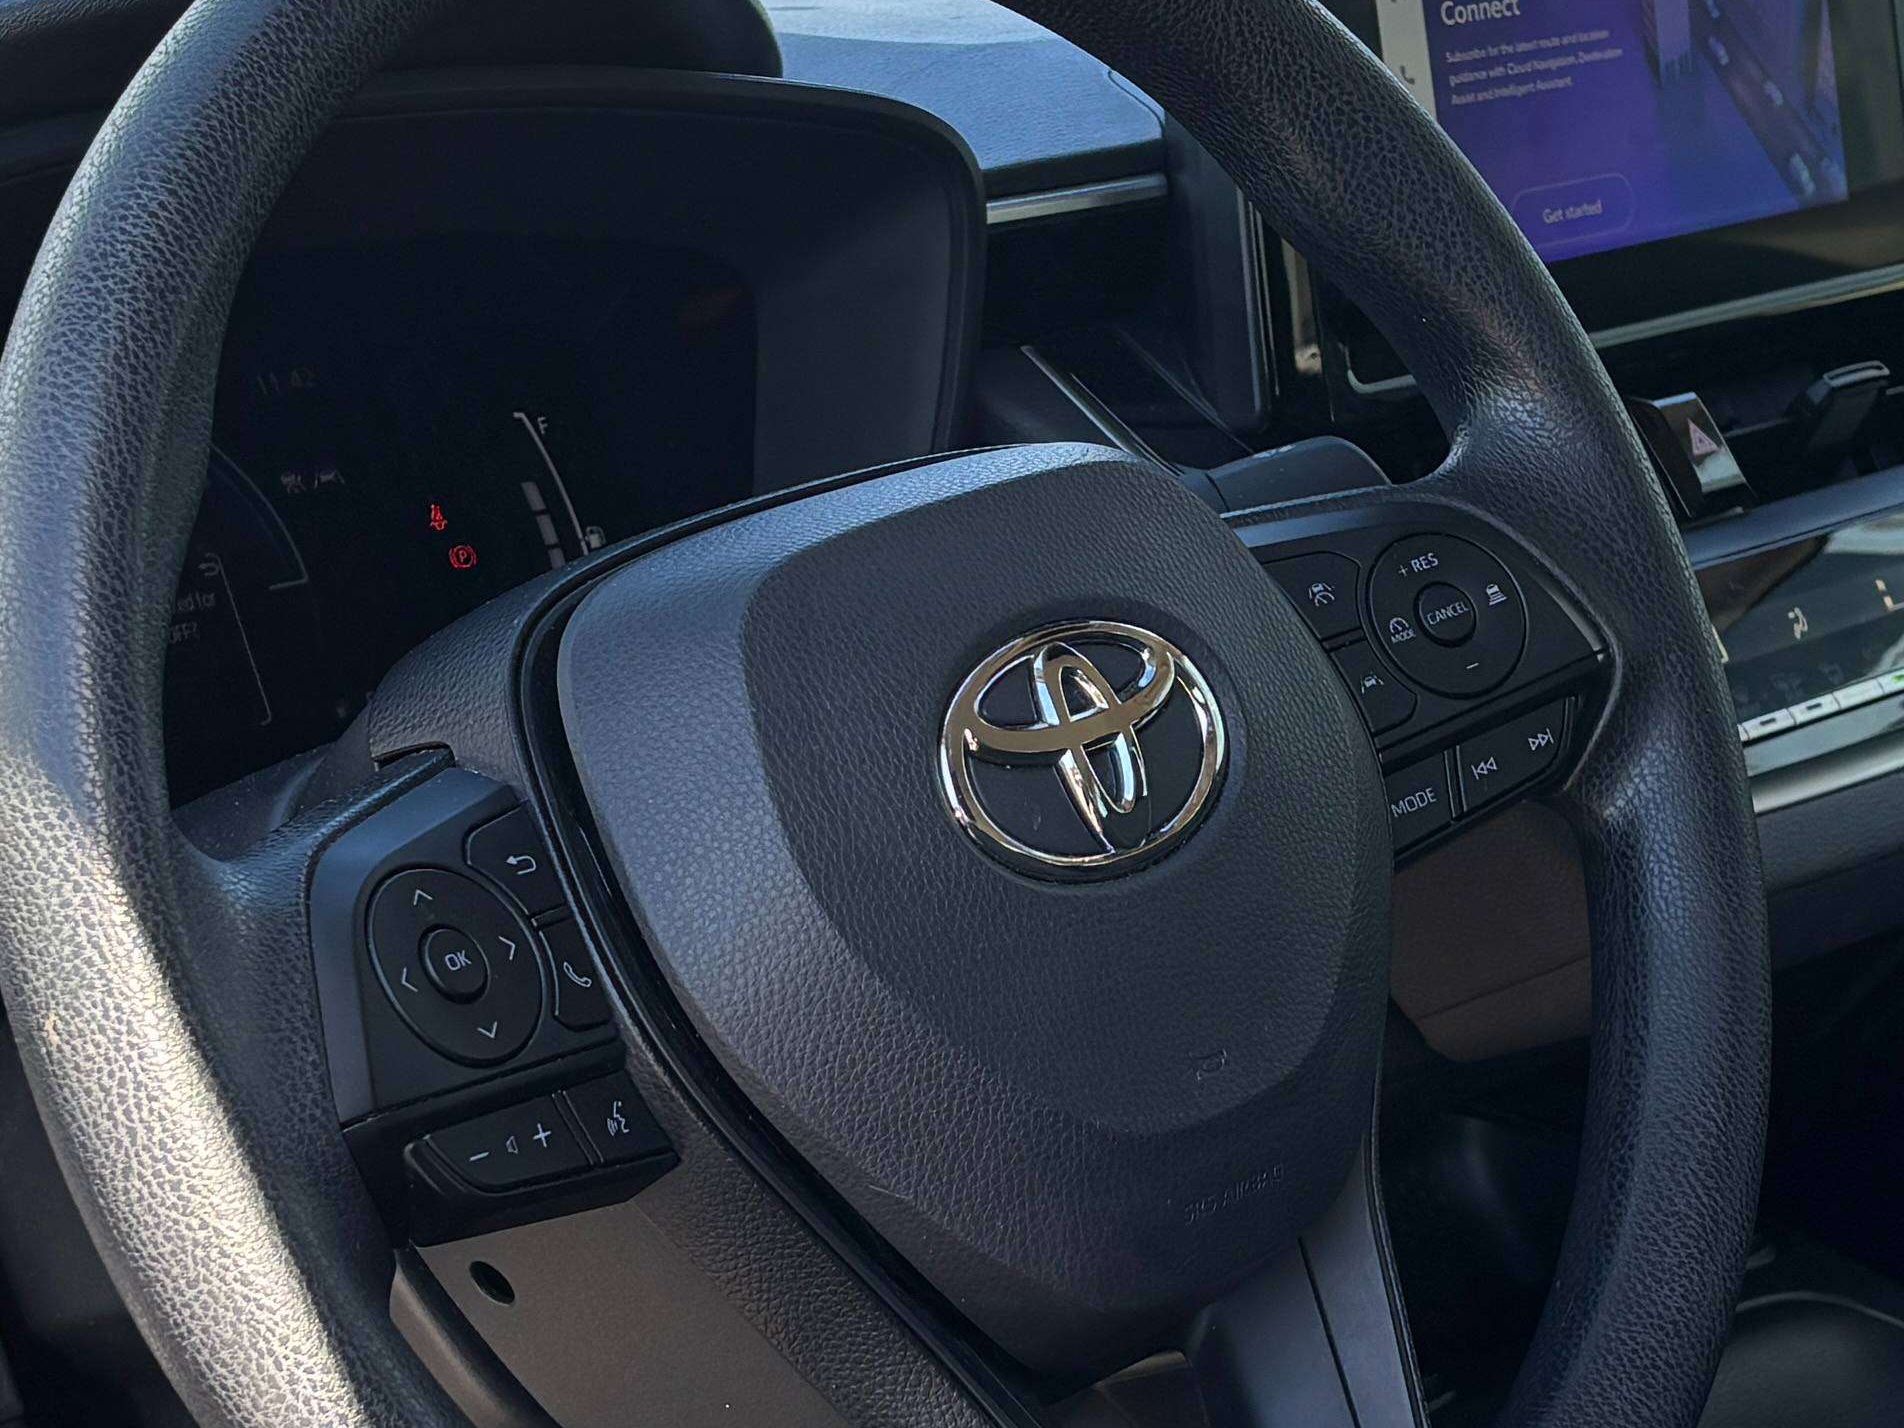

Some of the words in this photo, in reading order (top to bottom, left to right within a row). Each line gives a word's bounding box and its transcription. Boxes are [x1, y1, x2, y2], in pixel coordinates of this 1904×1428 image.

[1411, 552, 1440, 574] RES
[1426, 599, 1470, 626] CANCEL
[1390, 628, 1417, 644] MODE
[1390, 787, 1437, 817] MODE
[444, 949, 473, 972] OK
